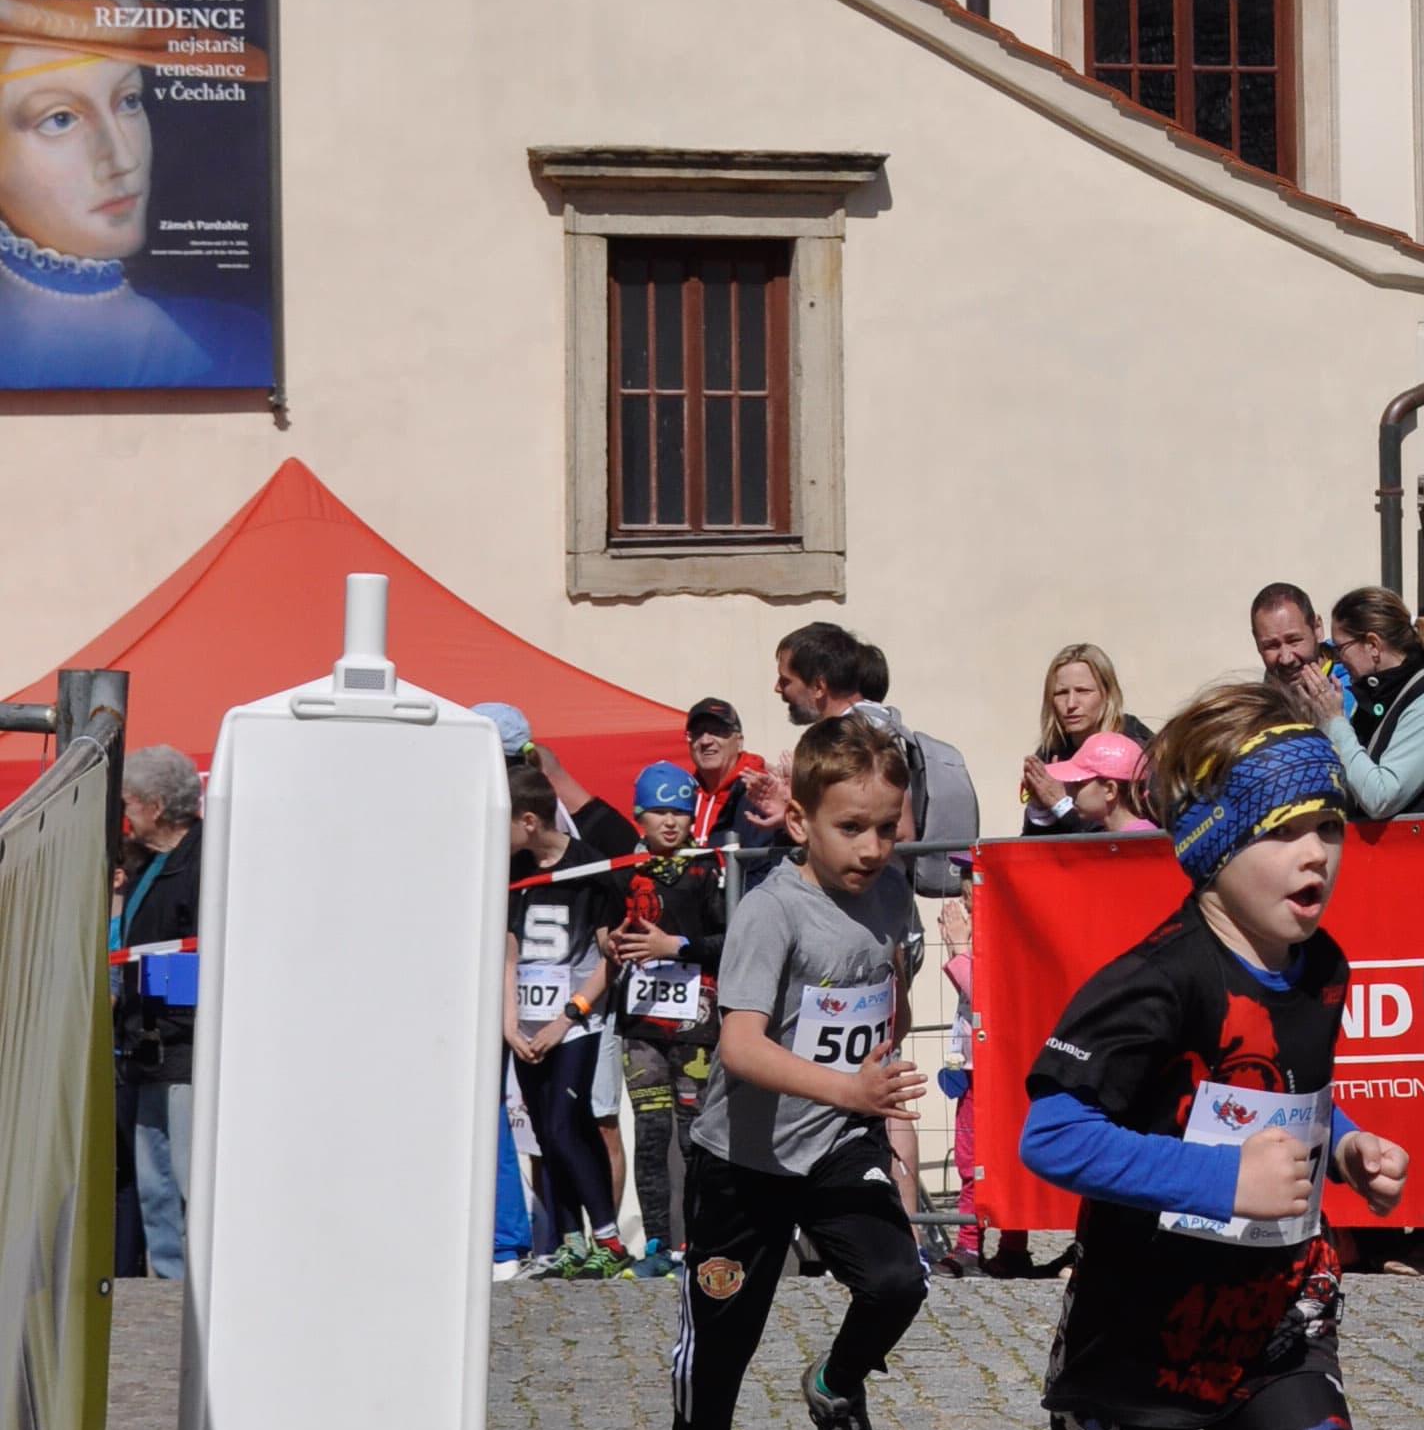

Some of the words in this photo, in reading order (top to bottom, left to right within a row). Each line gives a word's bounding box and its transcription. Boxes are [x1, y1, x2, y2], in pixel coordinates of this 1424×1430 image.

[95, 7, 245, 30] REZIDENCE
[168, 36, 245, 56] nejstarší
[155, 62, 246, 78] renesance
[154, 89, 167, 101] v
[170, 81, 246, 102] Čechách
[636, 979, 689, 1004] 2138
[812, 1017, 892, 1065] 501
